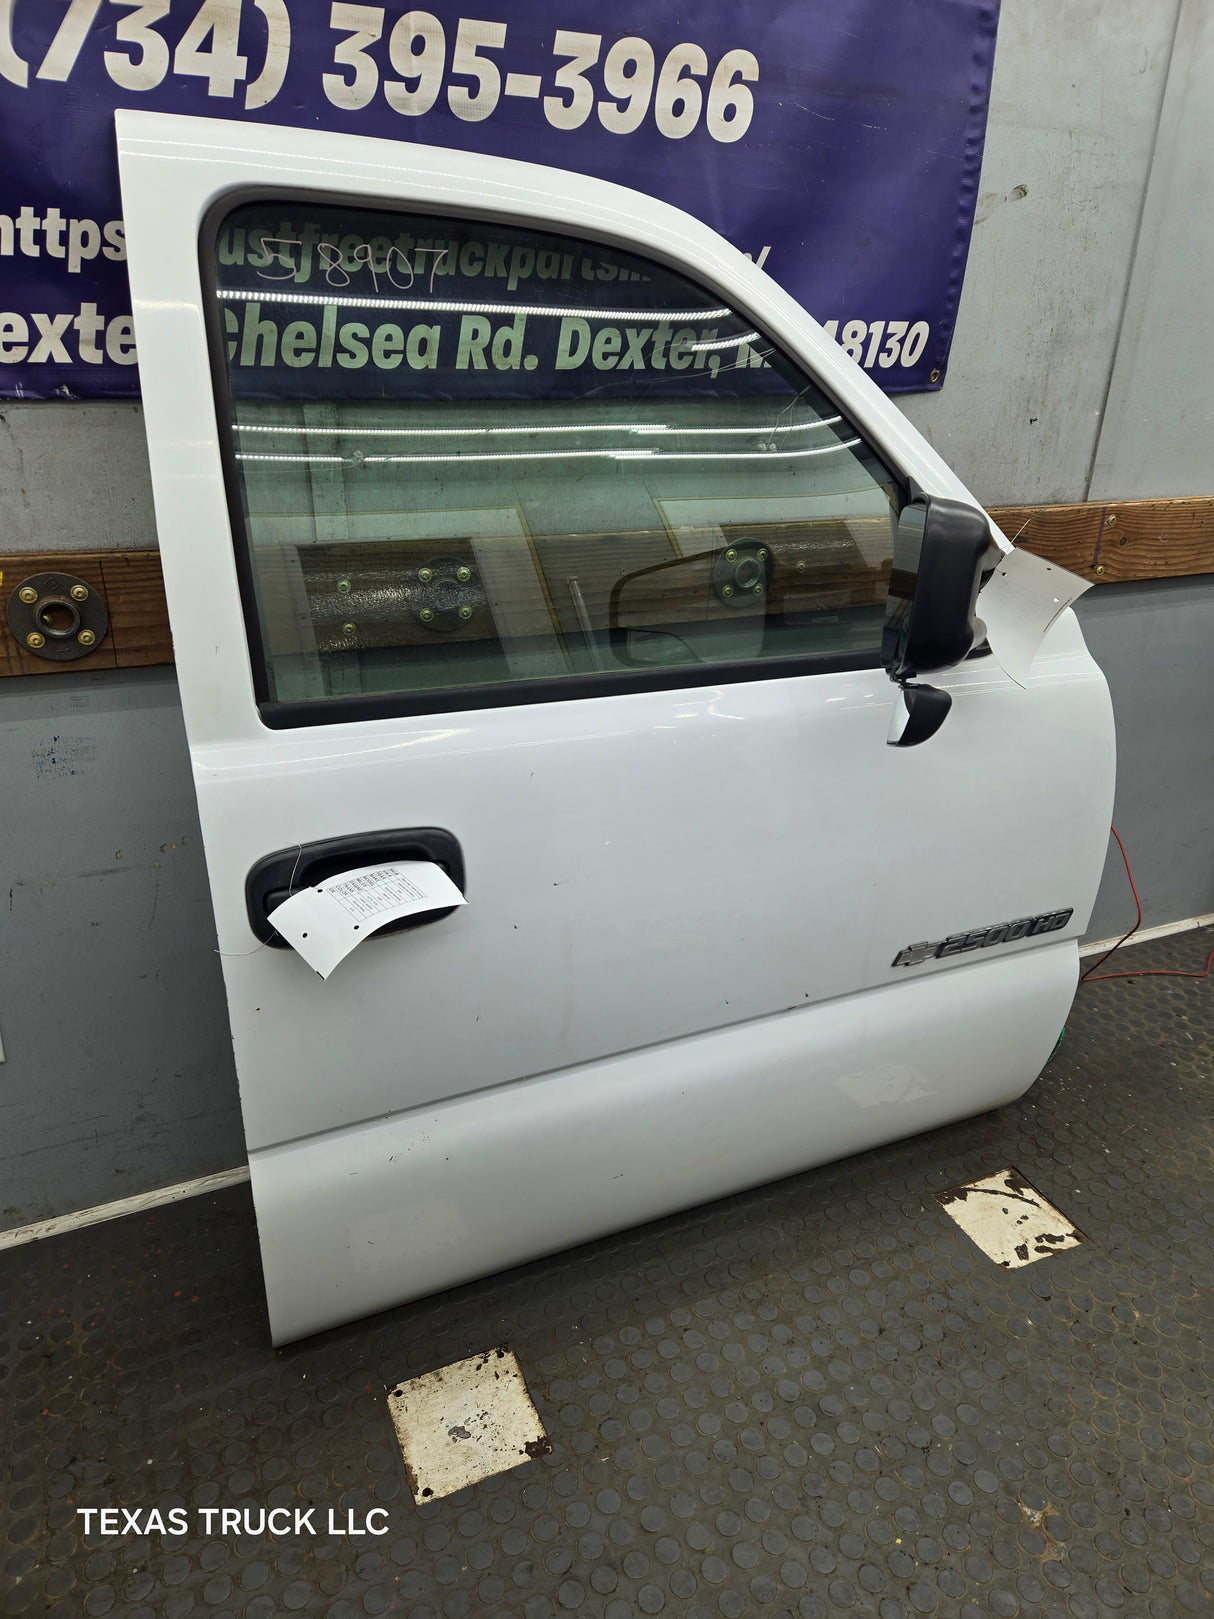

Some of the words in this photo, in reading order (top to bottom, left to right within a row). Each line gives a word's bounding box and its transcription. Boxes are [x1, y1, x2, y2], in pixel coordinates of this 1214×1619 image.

[322, 1, 760, 144] 395-3966
[256, 237, 449, 294] 58907
[455, 311, 539, 371] Rd.
[555, 316, 719, 379] Dexter,
